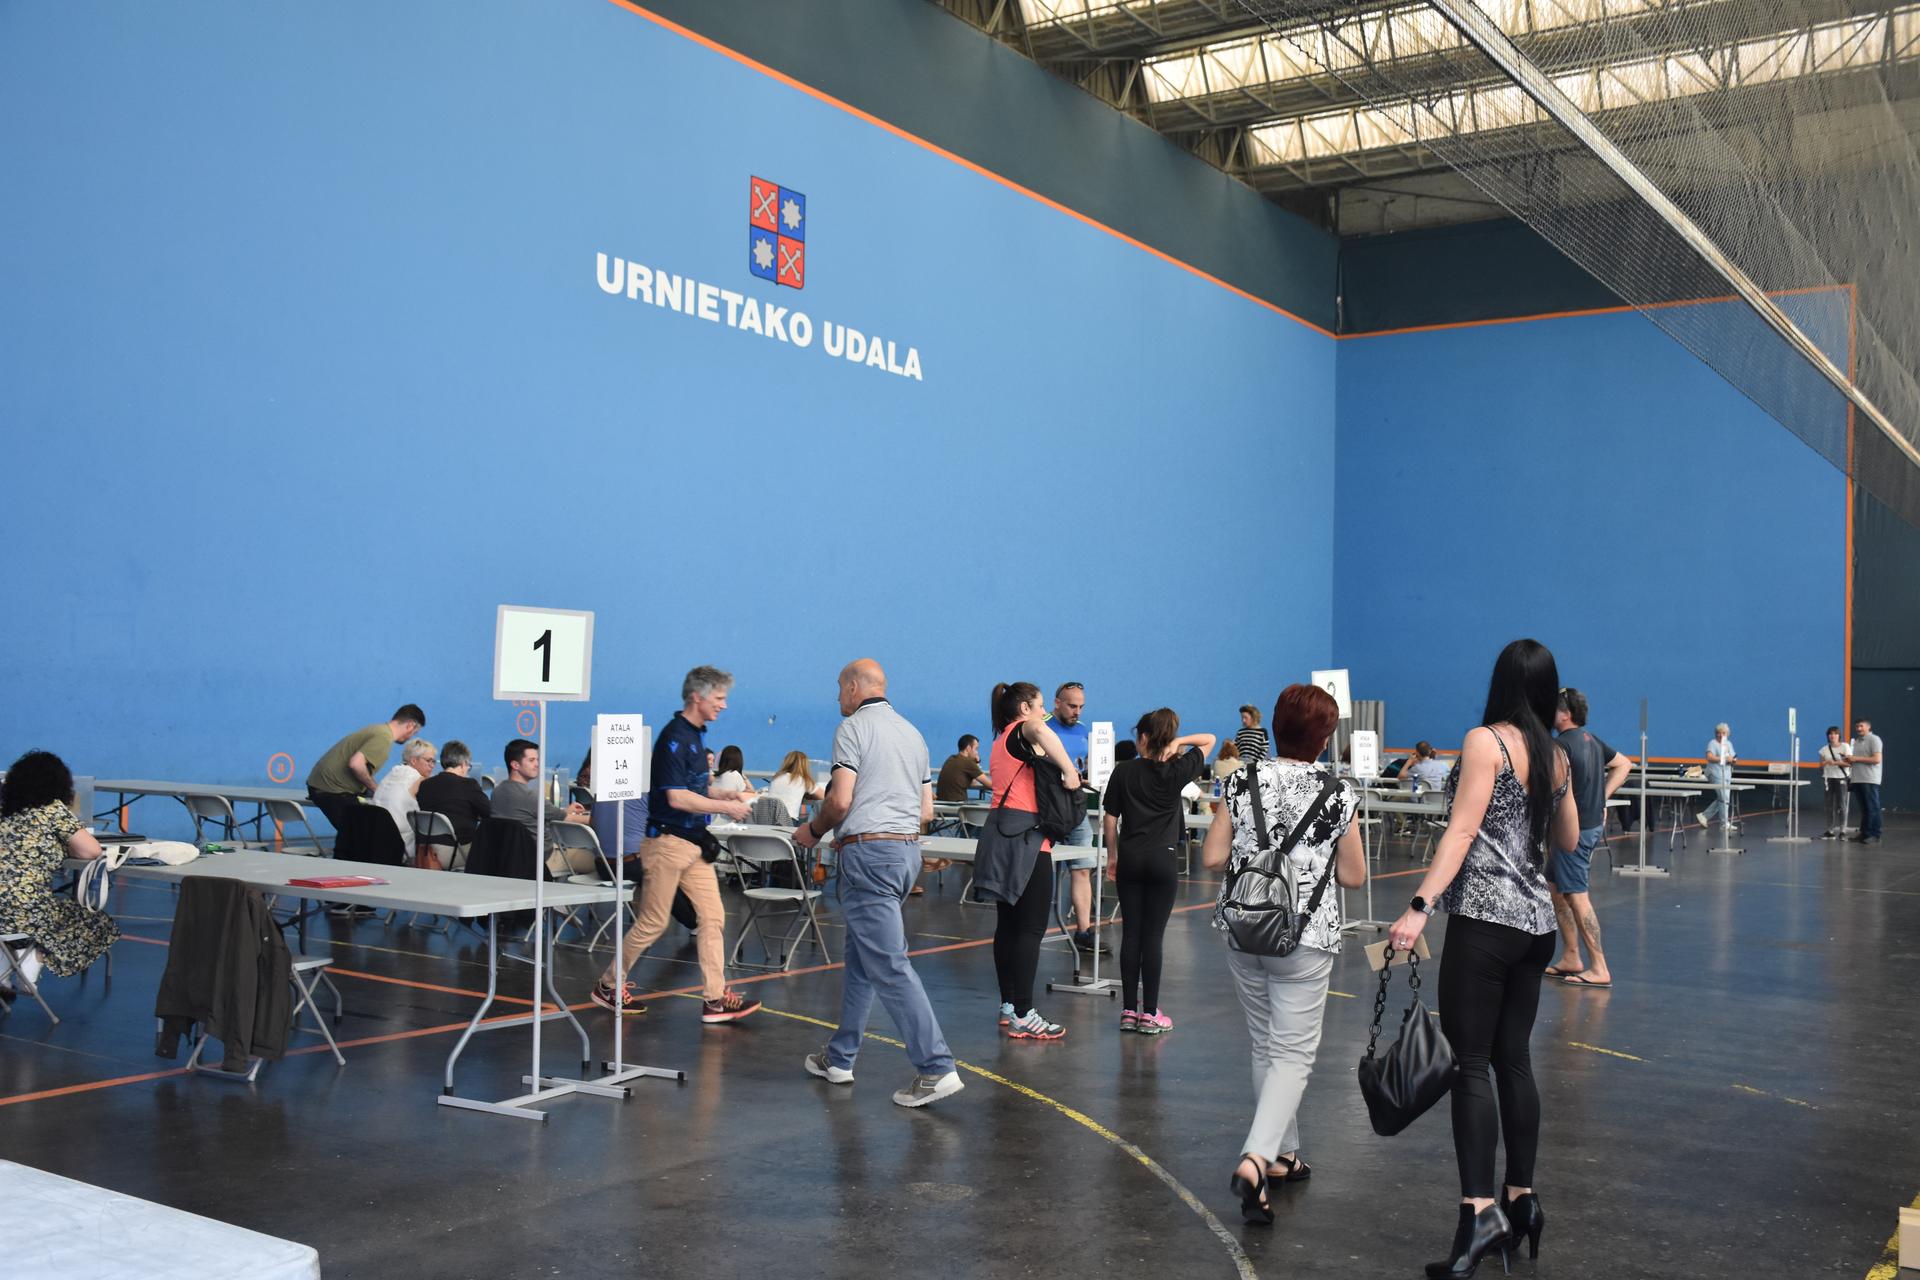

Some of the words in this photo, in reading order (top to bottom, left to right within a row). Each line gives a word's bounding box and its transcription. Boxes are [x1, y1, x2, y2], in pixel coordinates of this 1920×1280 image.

[597, 252, 813, 347] URNIETAKO
[823, 321, 923, 381] UDALA
[533, 629, 552, 682] 1
[610, 724, 631, 732] ATALA
[615, 759, 628, 770] 1-A
